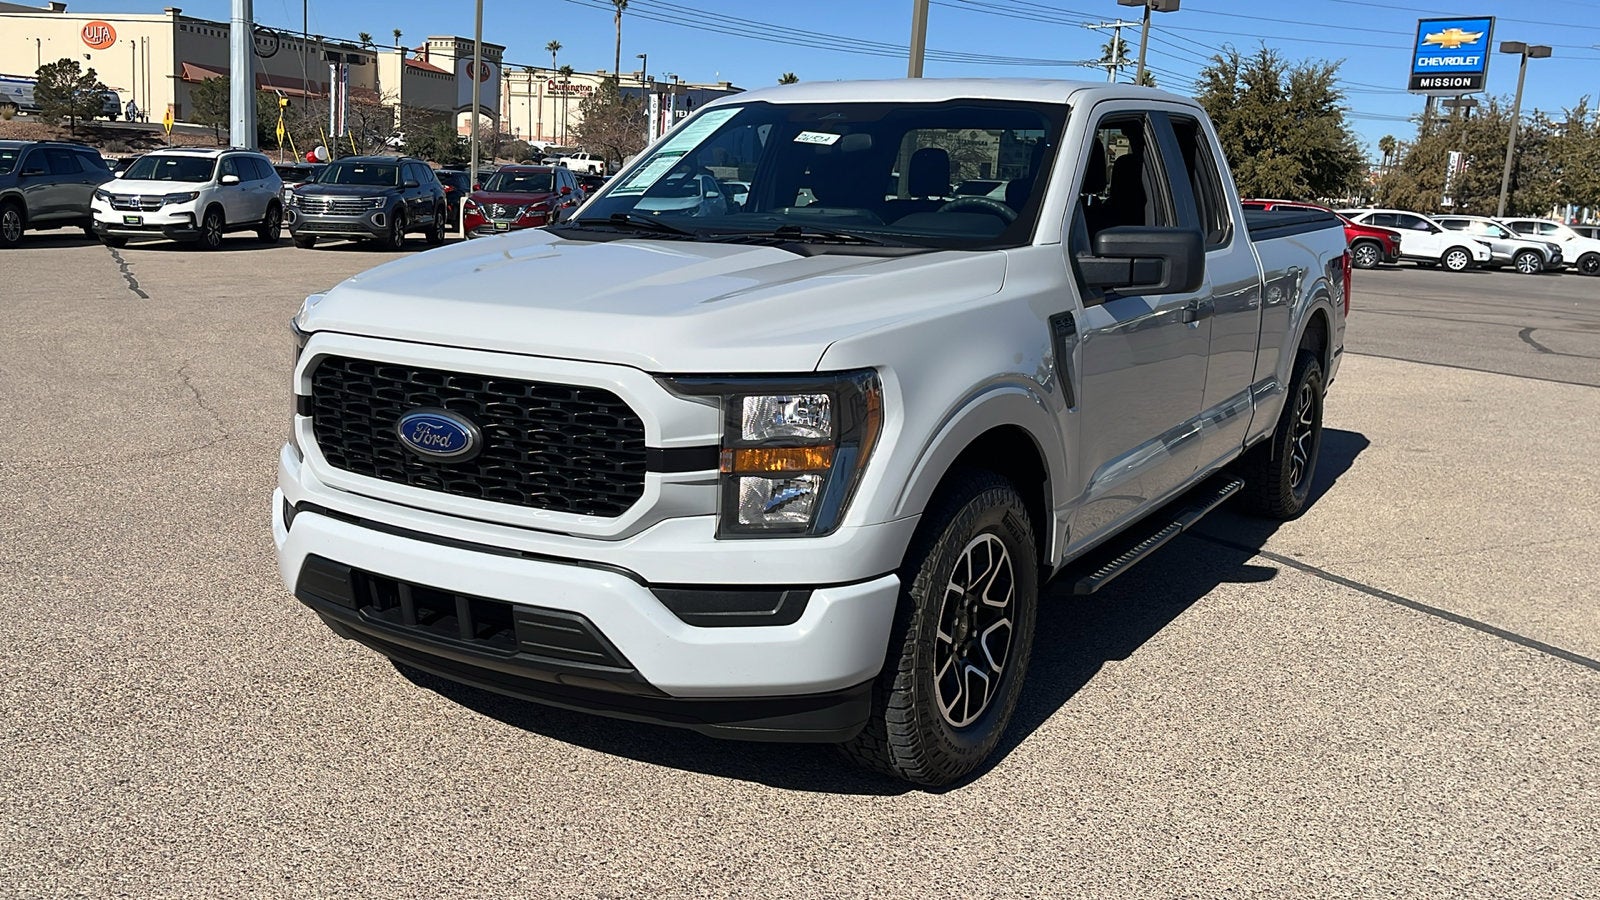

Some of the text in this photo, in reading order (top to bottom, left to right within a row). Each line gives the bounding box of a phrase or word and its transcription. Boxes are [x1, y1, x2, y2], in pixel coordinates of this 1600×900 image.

[84, 25, 112, 42] ULTA
[1417, 56, 1480, 67] CHEVROLET
[1420, 77, 1471, 87] MISSION
[412, 421, 452, 448] Ford
